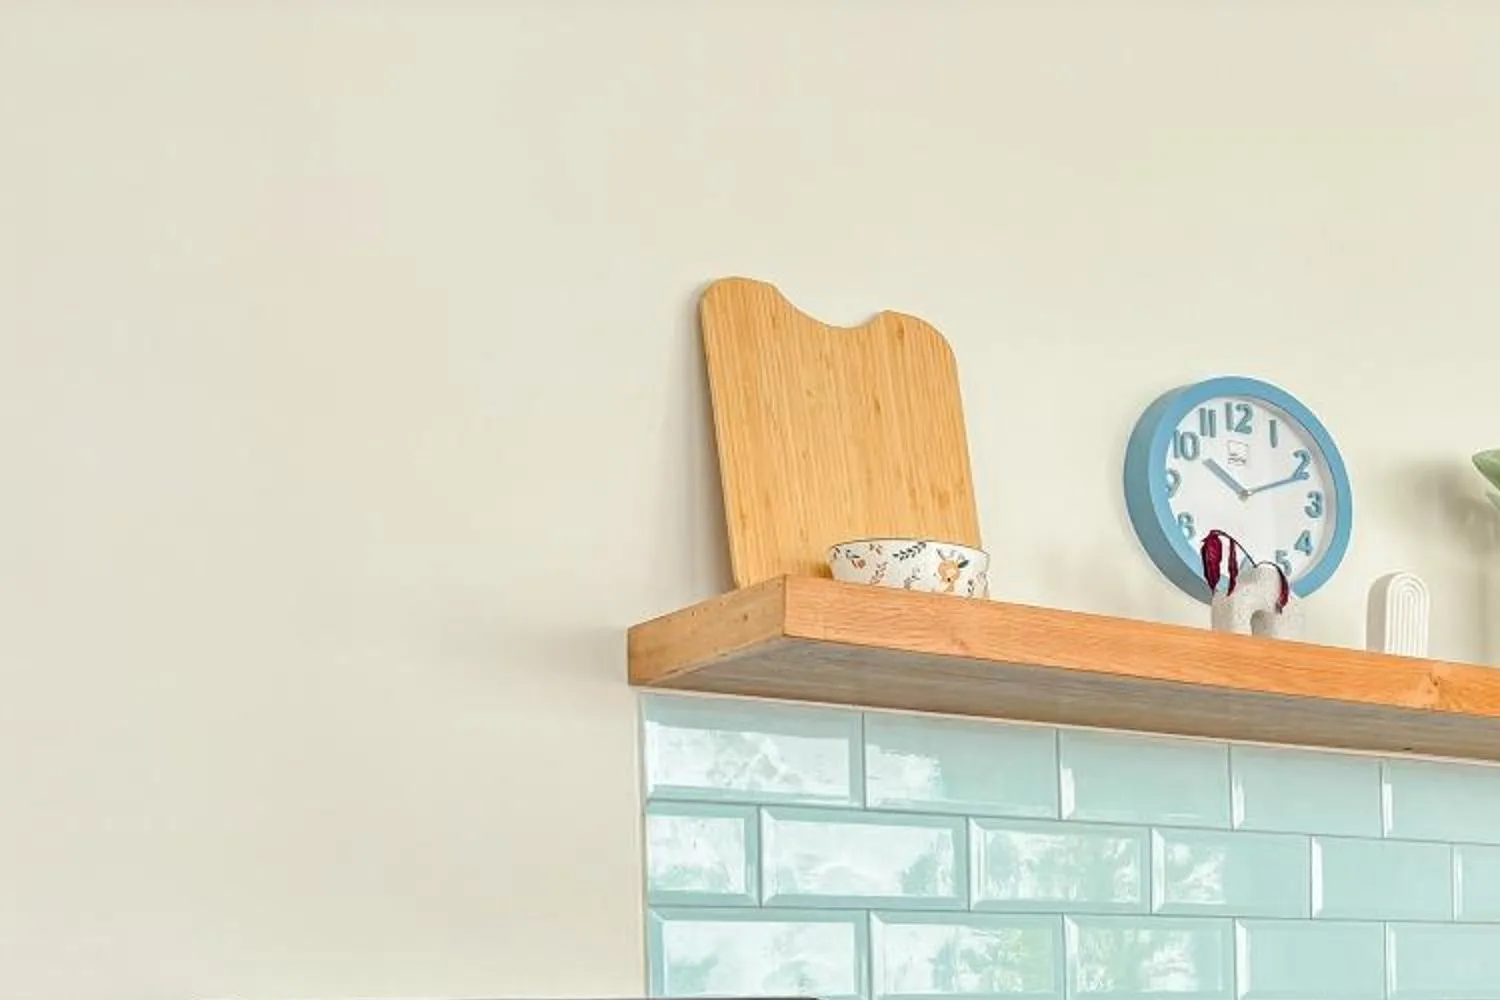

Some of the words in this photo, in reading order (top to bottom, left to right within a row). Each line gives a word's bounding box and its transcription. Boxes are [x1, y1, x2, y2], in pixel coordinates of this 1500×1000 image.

[1199, 407, 1217, 438] 11
[1225, 402, 1252, 434] 12
[1173, 431, 1200, 460] 10
[1269, 419, 1279, 448] 1
[1293, 450, 1311, 480] 2
[1304, 491, 1323, 518] 3
[1294, 530, 1312, 556] 4
[1275, 550, 1292, 576] 5
